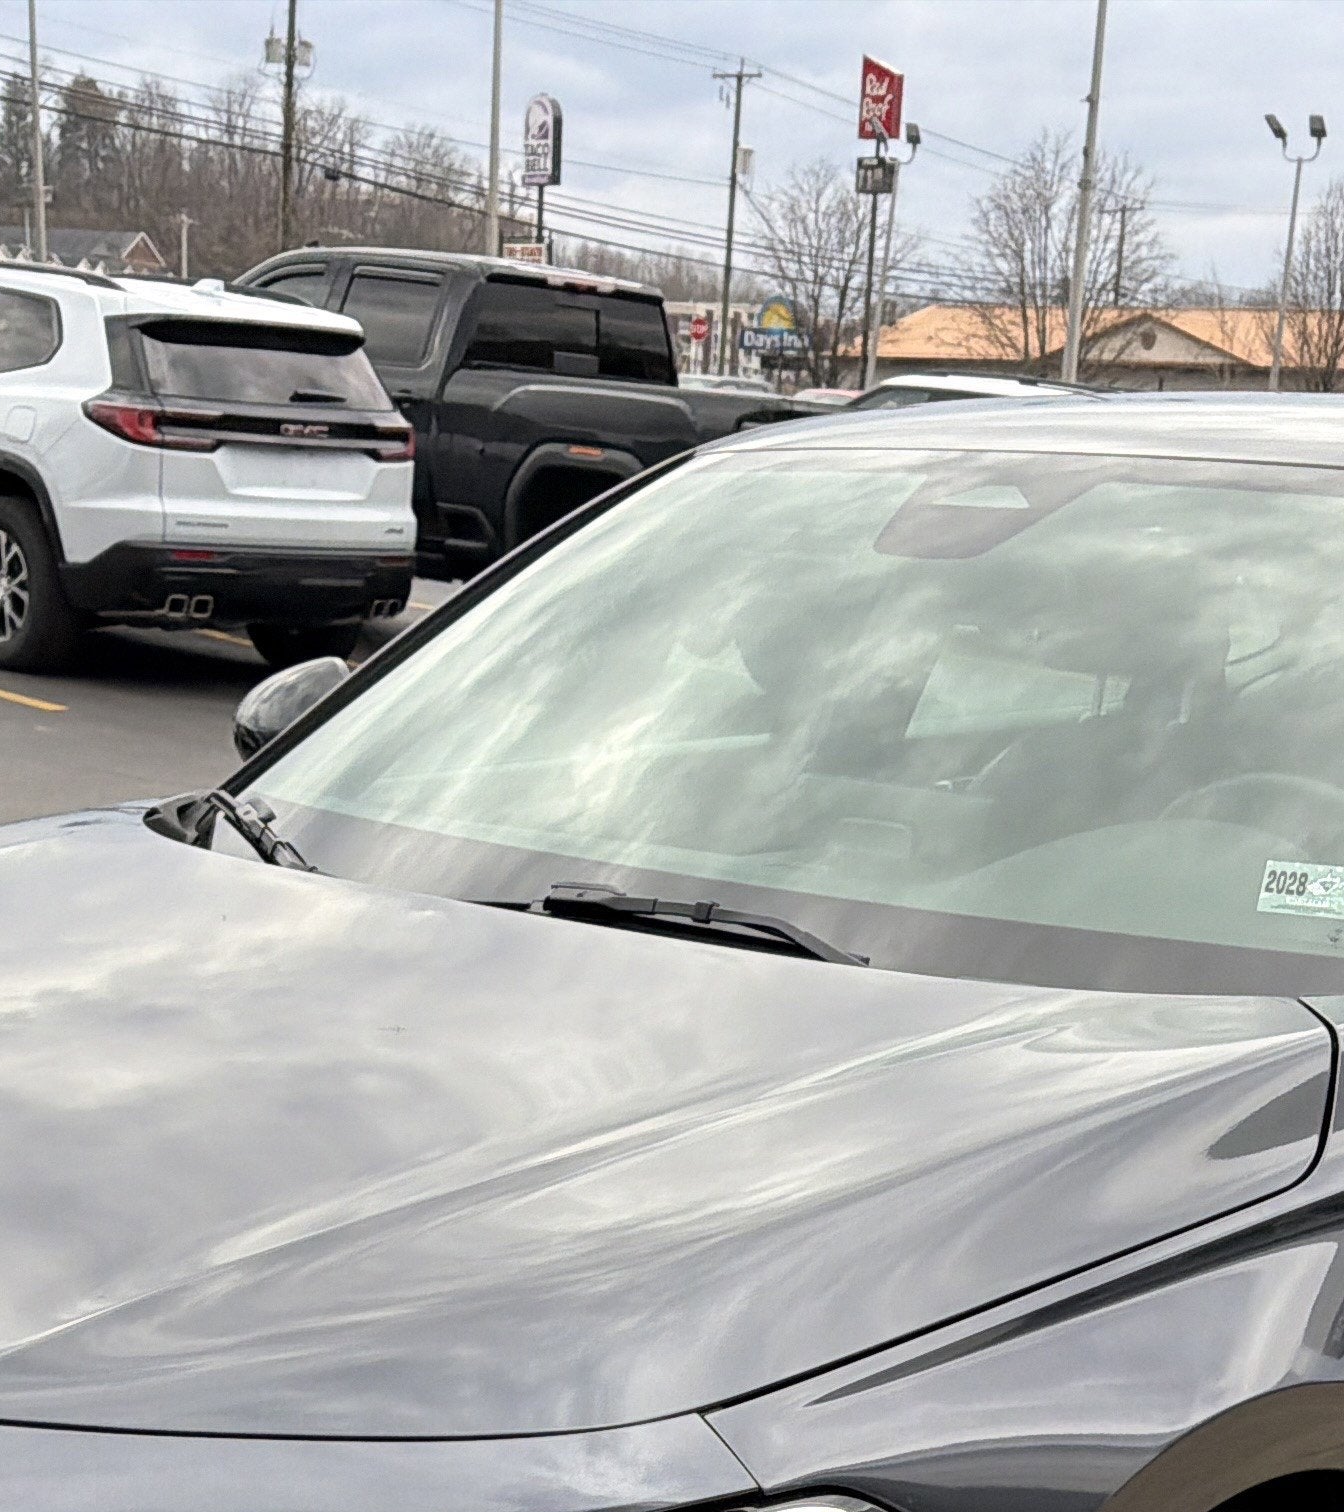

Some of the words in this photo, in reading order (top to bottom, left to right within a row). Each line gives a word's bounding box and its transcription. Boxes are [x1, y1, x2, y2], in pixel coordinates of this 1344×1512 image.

[743, 330, 781, 349] Days
[279, 423, 330, 439] GMC
[1264, 869, 1309, 897] 2028
